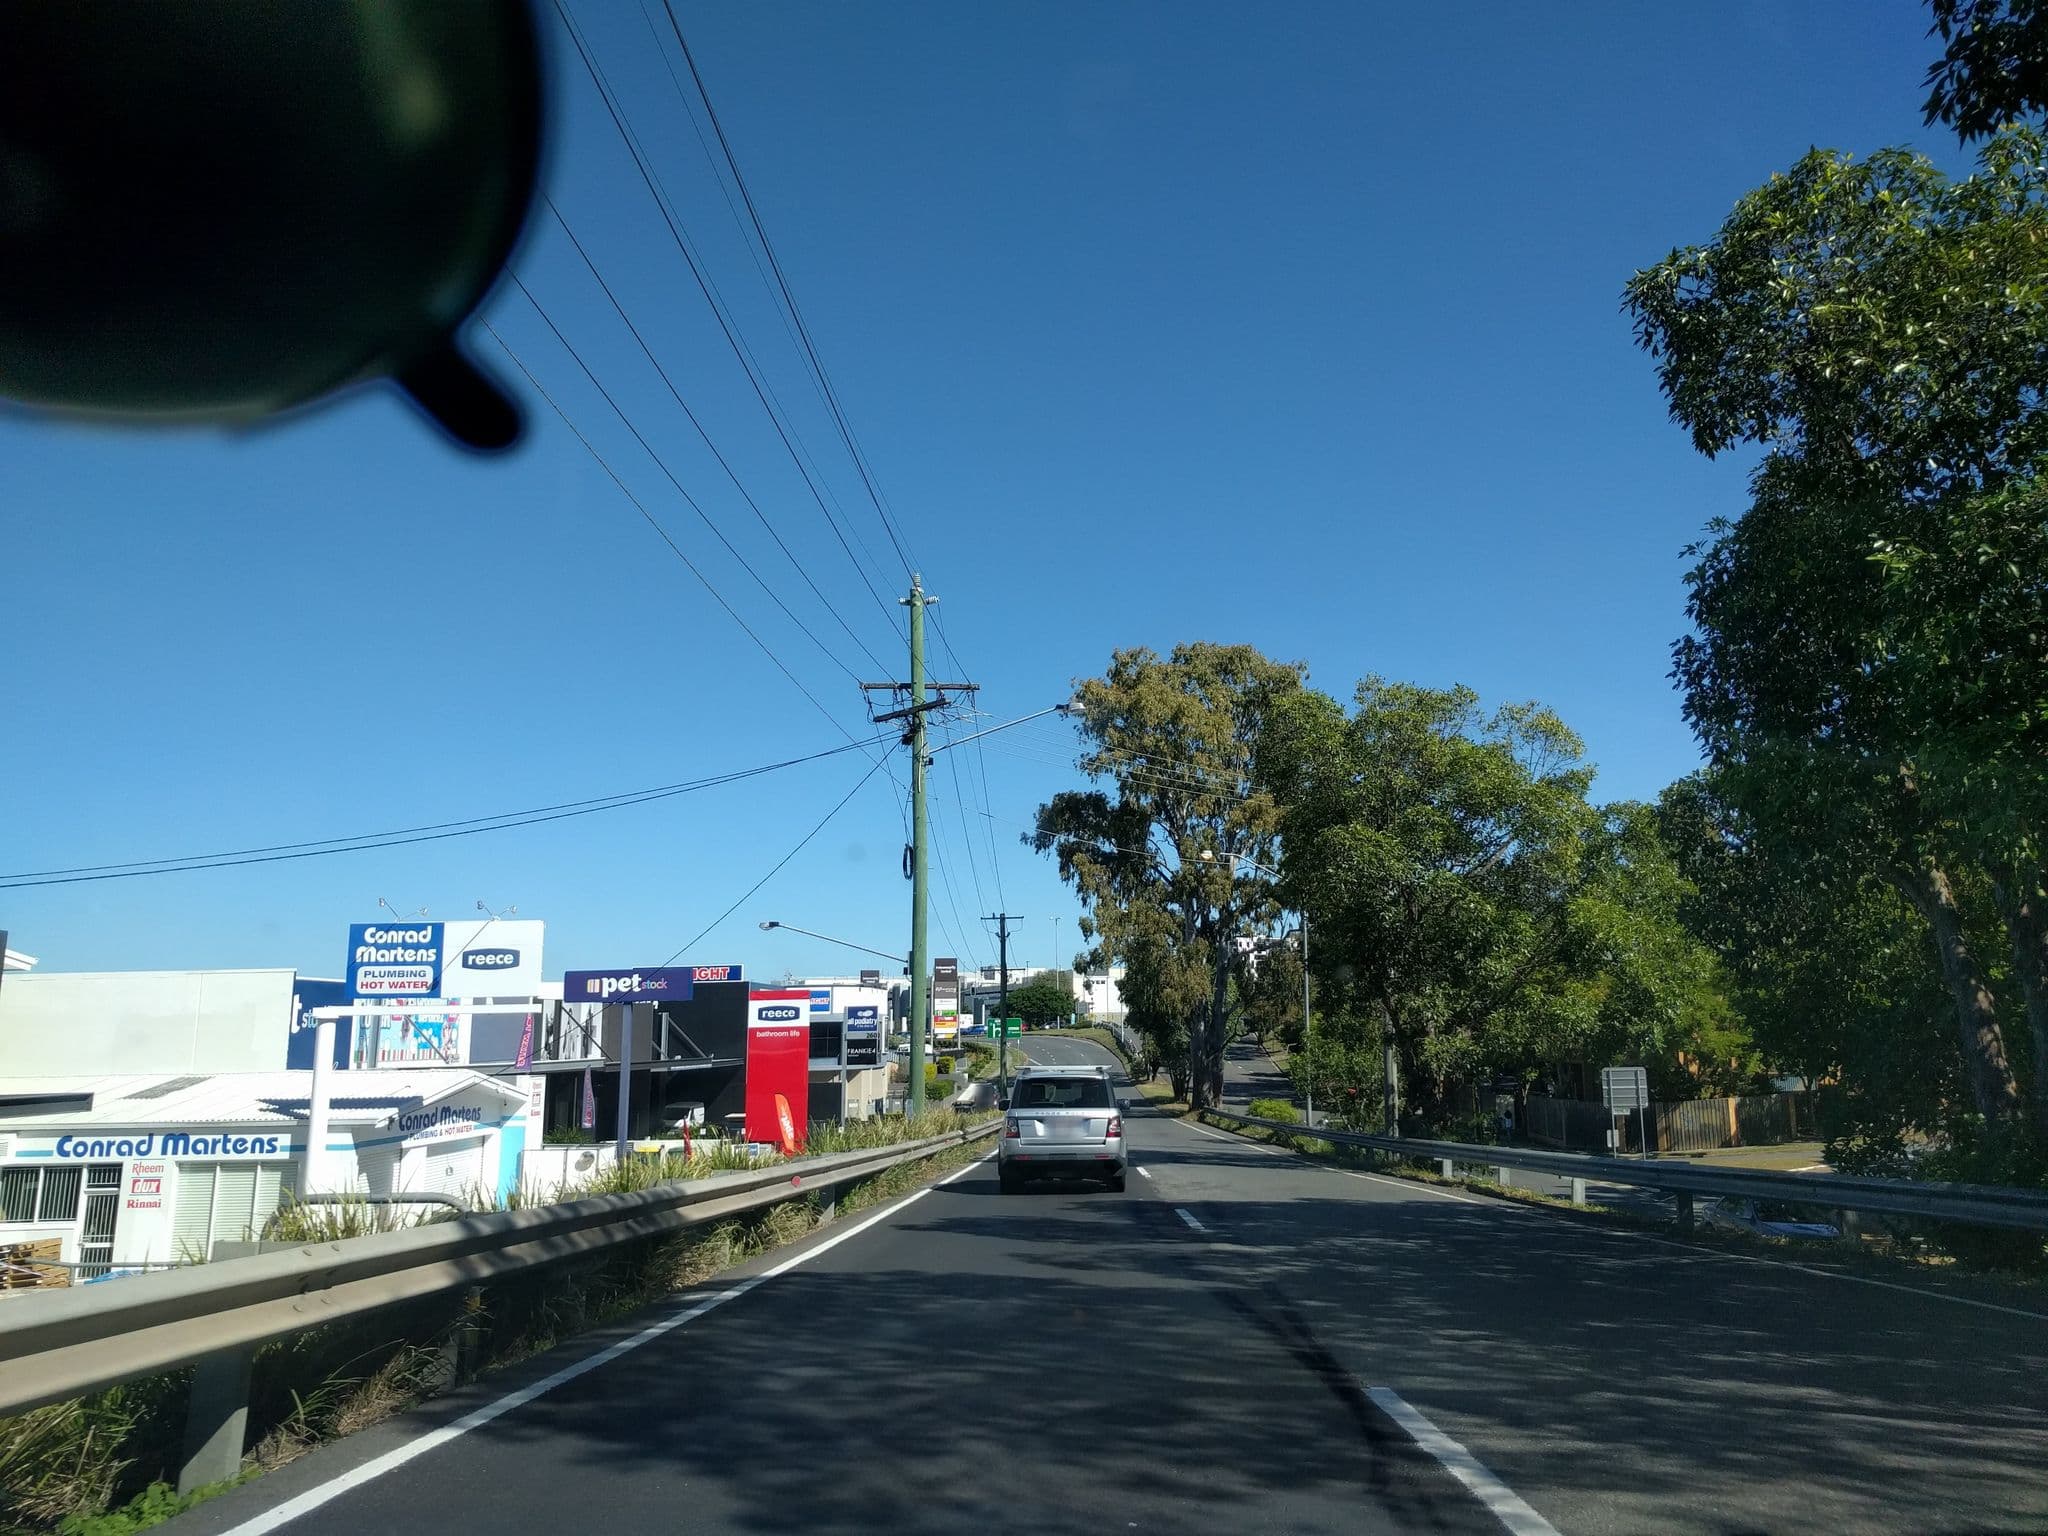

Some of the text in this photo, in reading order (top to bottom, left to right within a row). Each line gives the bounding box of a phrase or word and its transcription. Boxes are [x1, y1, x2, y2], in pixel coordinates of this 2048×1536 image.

[364, 925, 432, 944] Conrad
[356, 946, 437, 963] Martens
[467, 953, 514, 966] reece
[364, 970, 427, 979] PLUMBING
[360, 980, 429, 990] HOT WATER
[761, 1009, 796, 1019] reece
[756, 1029, 800, 1038] bathroom life
[399, 1105, 482, 1132] Conrad Martens
[445, 1127, 456, 1136] HOT
[56, 1132, 279, 1158] Conrad Martens
[132, 1161, 164, 1176] Rheem
[132, 1179, 161, 1193] dux
[127, 1198, 162, 1209] Rinnai
